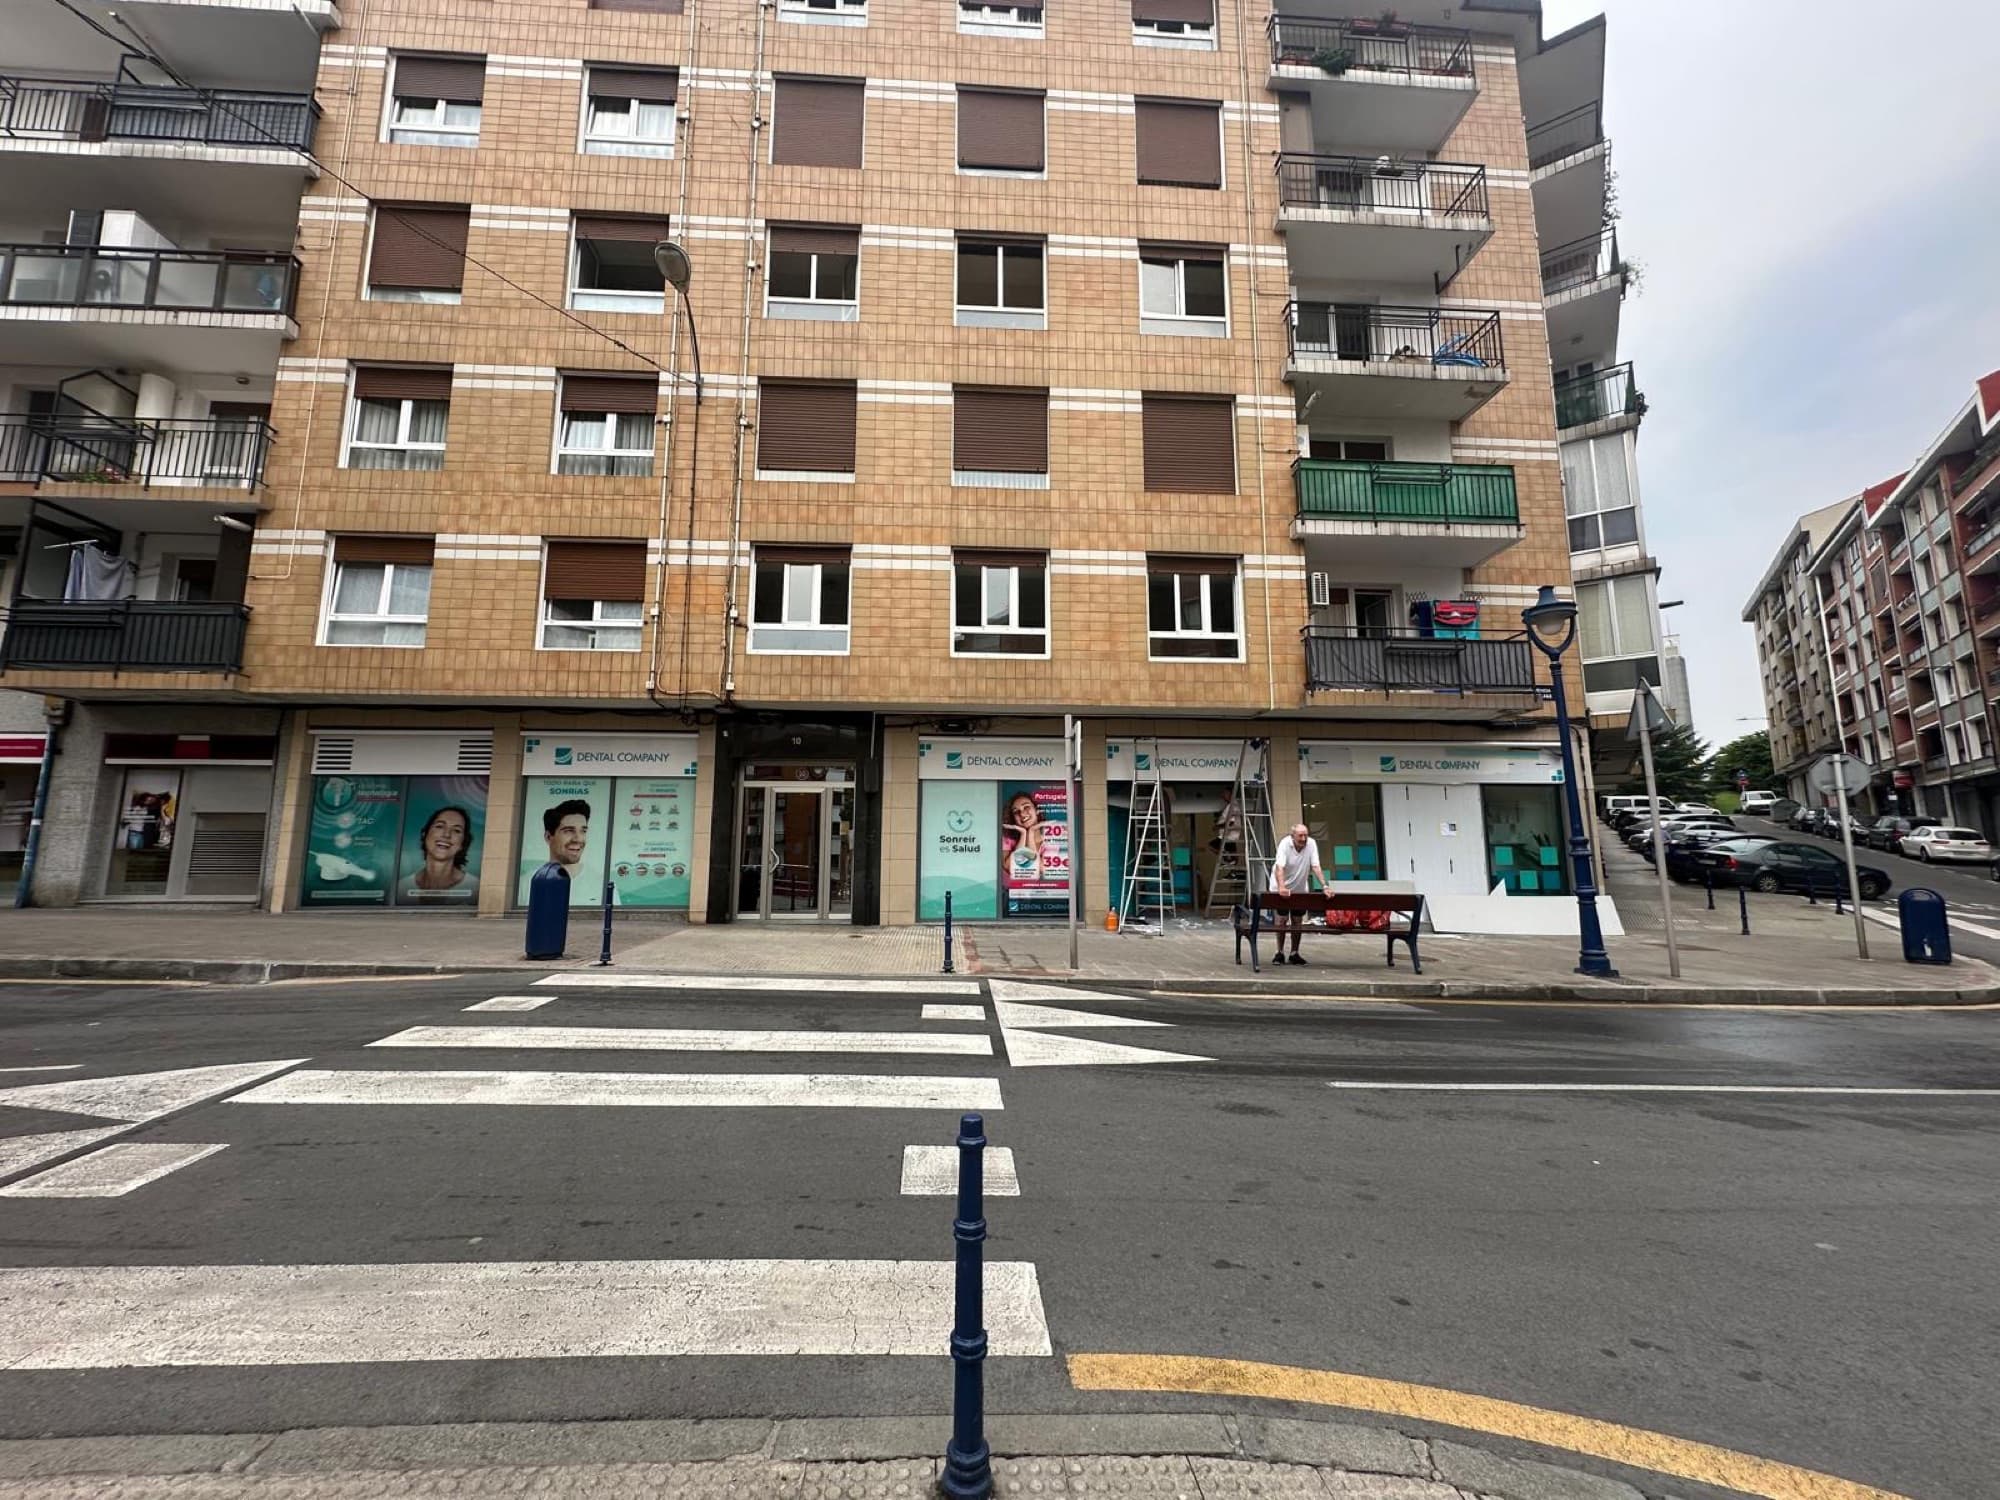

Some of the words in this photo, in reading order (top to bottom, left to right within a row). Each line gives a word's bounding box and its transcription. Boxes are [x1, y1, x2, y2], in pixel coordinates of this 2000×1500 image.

[791, 736, 802, 745] 10
[576, 752, 614, 762] DENTAL
[617, 752, 670, 763] COMPANY
[967, 756, 1002, 766] DENTAL
[1004, 757, 1054, 767] COMPANY
[1190, 758, 1238, 768] COMPANY
[1400, 759, 1432, 770] DENTAL
[1435, 759, 1480, 771] COMPANY
[1034, 793, 1067, 801] Portugale
[952, 844, 981, 853] Salud
